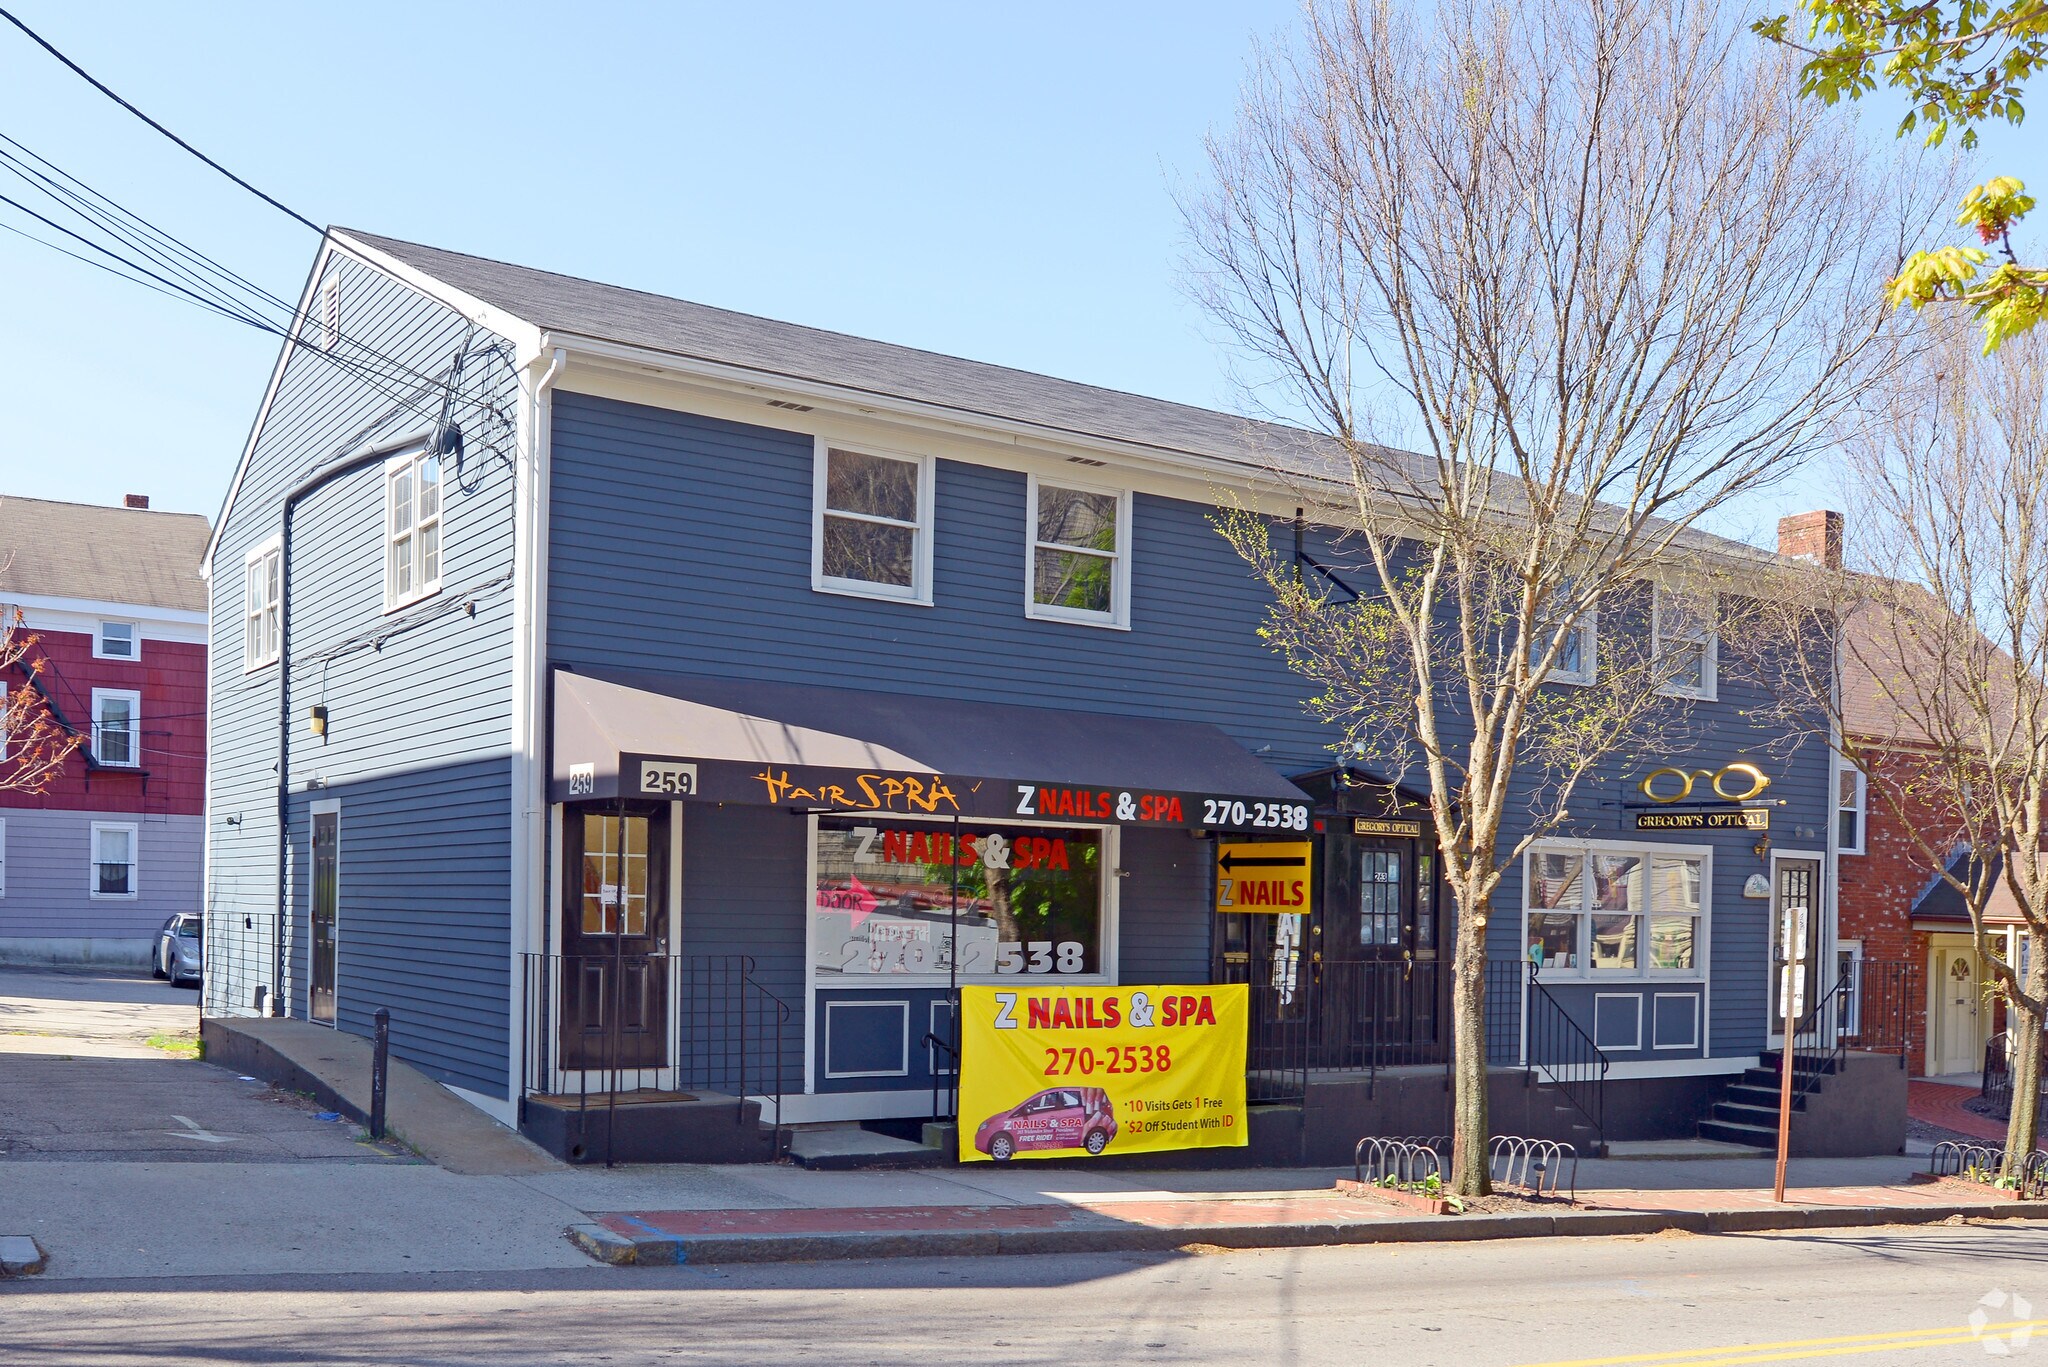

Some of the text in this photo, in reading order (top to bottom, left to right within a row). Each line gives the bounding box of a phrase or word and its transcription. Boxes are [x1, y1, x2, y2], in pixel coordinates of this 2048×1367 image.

[571, 772, 592, 794] 259
[645, 771, 693, 795] 259
[750, 766, 856, 806] HAIR
[1016, 785, 1309, 831] Z NAILS & SPA 270-2538
[1357, 821, 1419, 833] GREGORY'S OPTICAL
[1637, 813, 1766, 827] GREGORY'S OPTICAL
[853, 827, 1069, 871] Z NAILS & SPA
[820, 891, 863, 911] DOOR
[1219, 879, 1304, 906] Z NAILS
[994, 991, 1217, 1029] Z NAILS & SPA
[1044, 1044, 1172, 1076] 270-2538
[1129, 1096, 1223, 1112] 10 Visits Gets 1 Free
[1003, 1117, 1083, 1130] Z NAILS & SPA
[1128, 1114, 1234, 1135] $2 Off Student With ID
